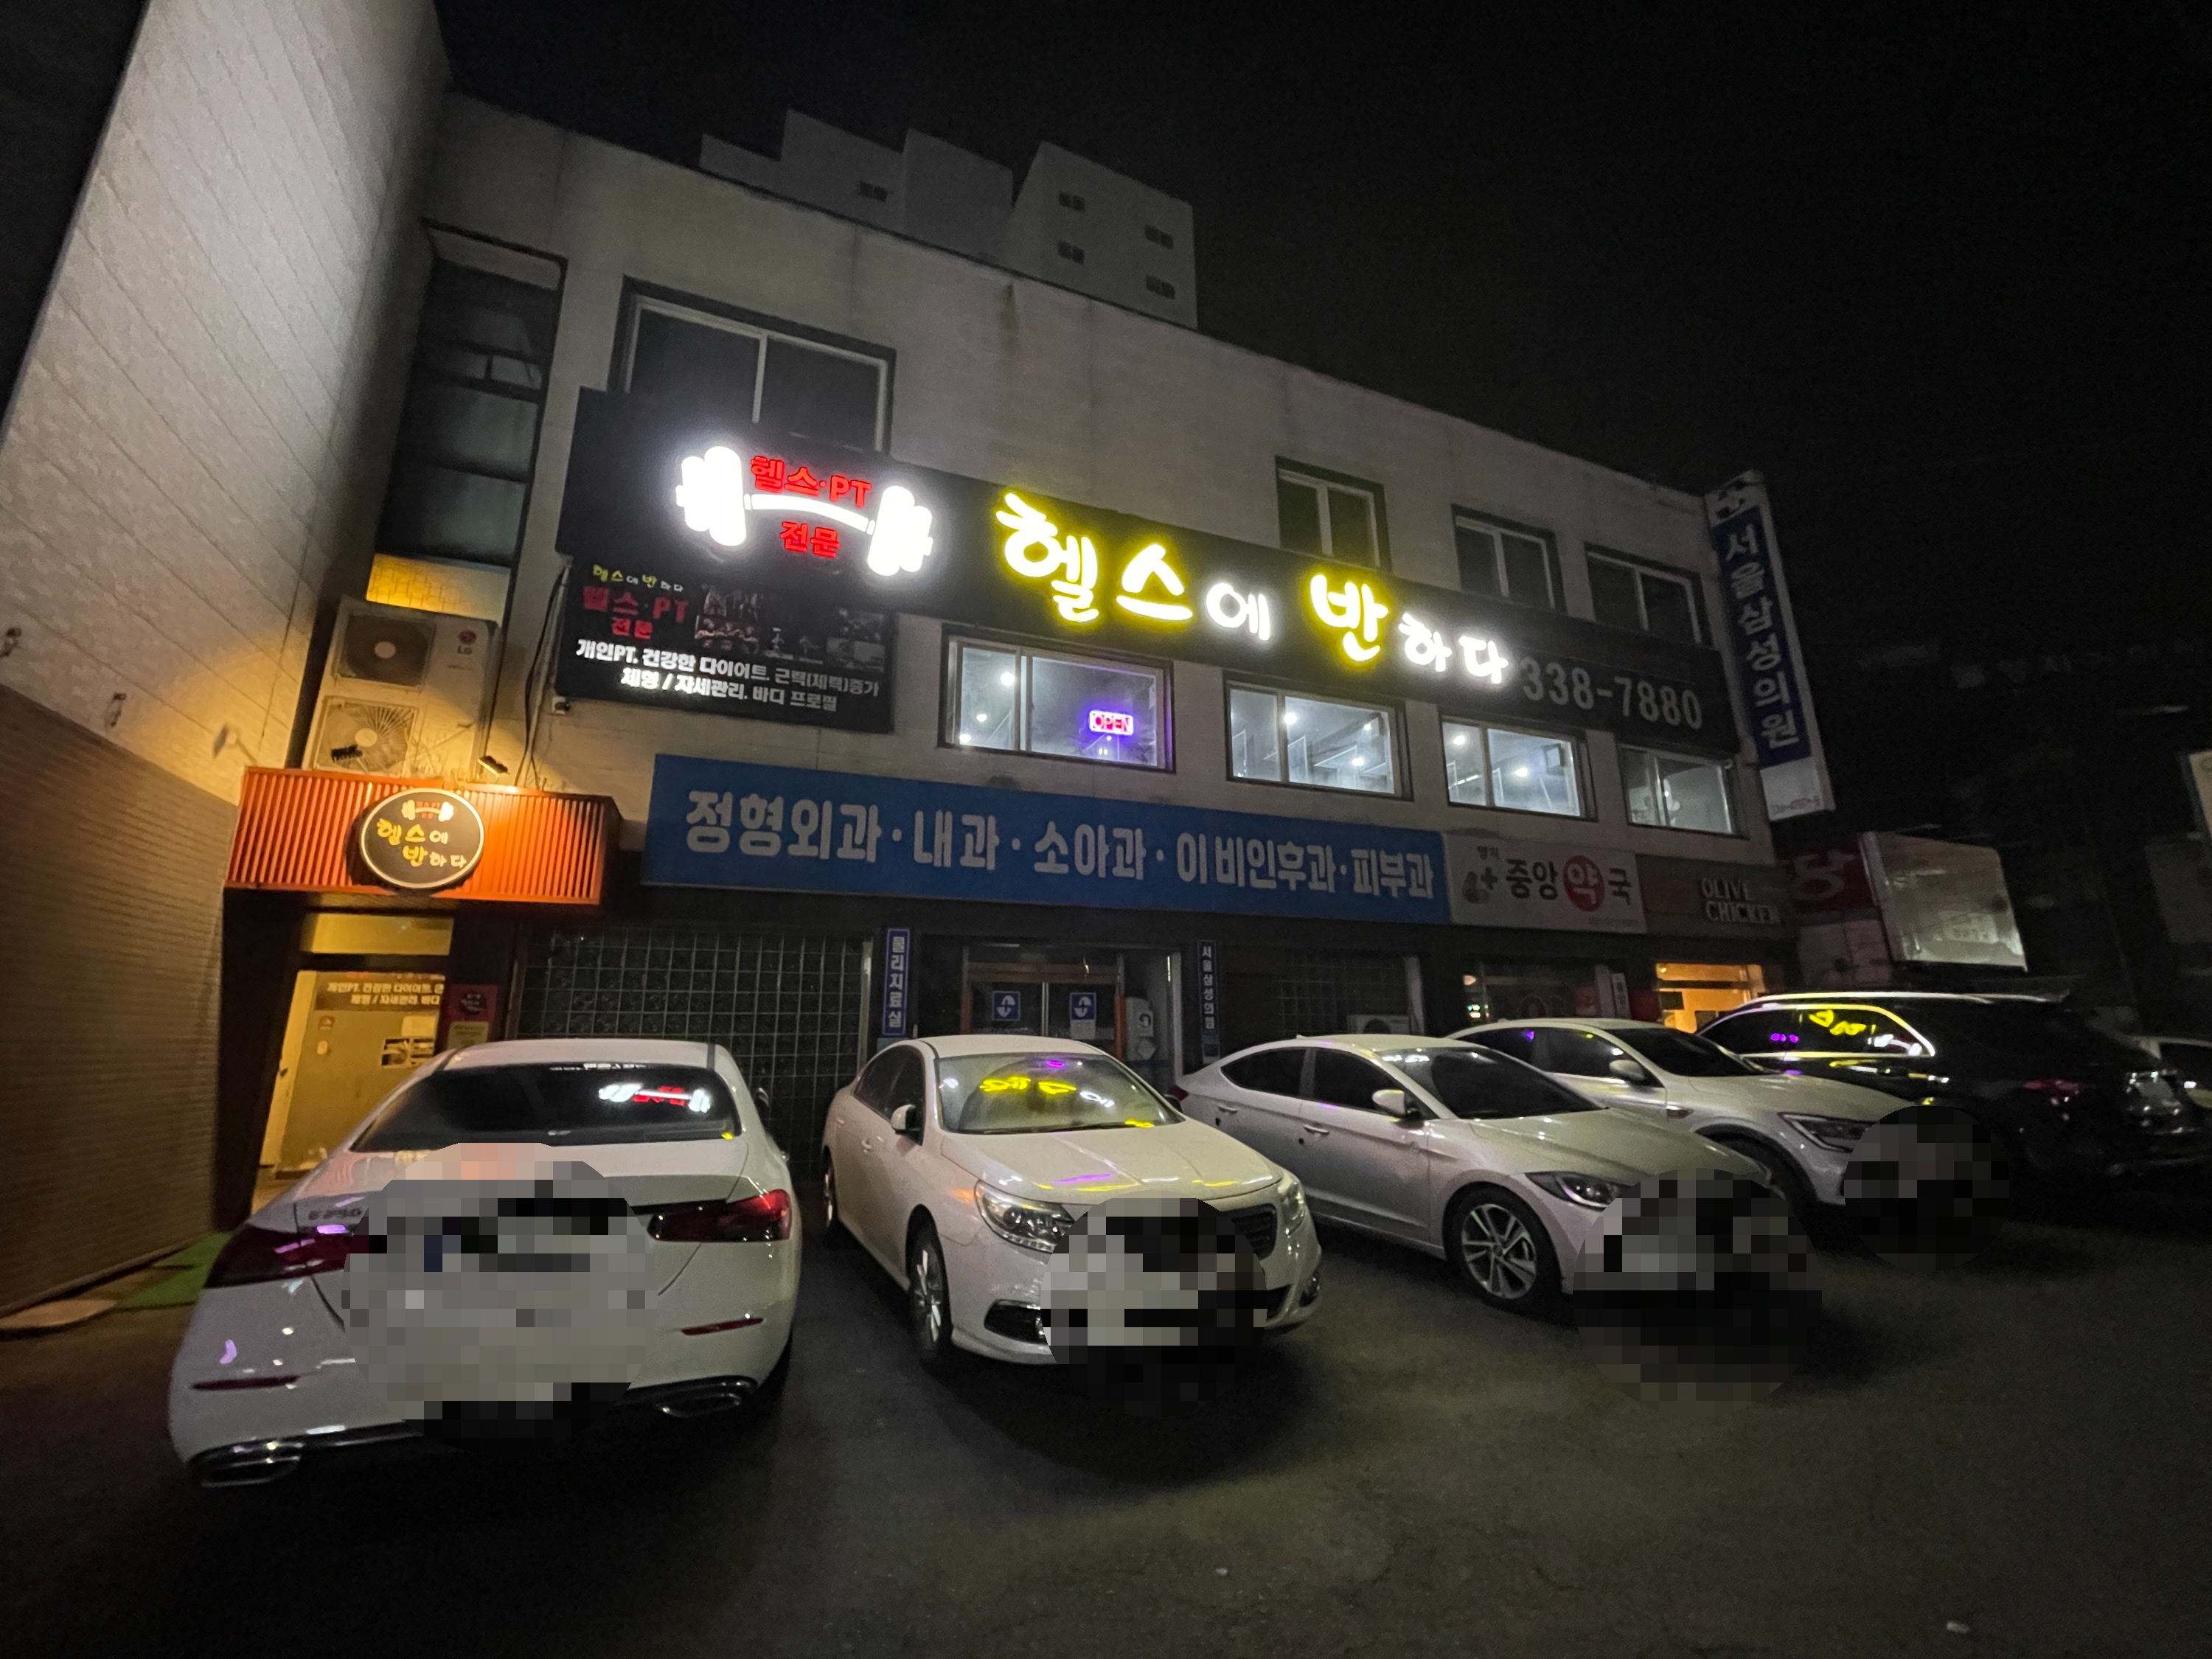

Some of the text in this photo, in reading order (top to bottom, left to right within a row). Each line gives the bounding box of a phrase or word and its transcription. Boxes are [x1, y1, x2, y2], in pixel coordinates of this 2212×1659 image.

[779, 521, 841, 559] 전문
[995, 492, 1509, 685] 헬스에 반하다
[1725, 523, 1800, 750] 서울삼성의원
[642, 647, 697, 672] 건강한
[753, 685, 785, 706] 바디
[790, 690, 838, 712] 프로필
[1520, 656, 1703, 730] 338-7880
[1091, 712, 1132, 734] OPEN
[376, 818, 448, 846] 헬스에
[402, 844, 467, 869] 반하다
[1506, 858, 1632, 906] 중앙약국
